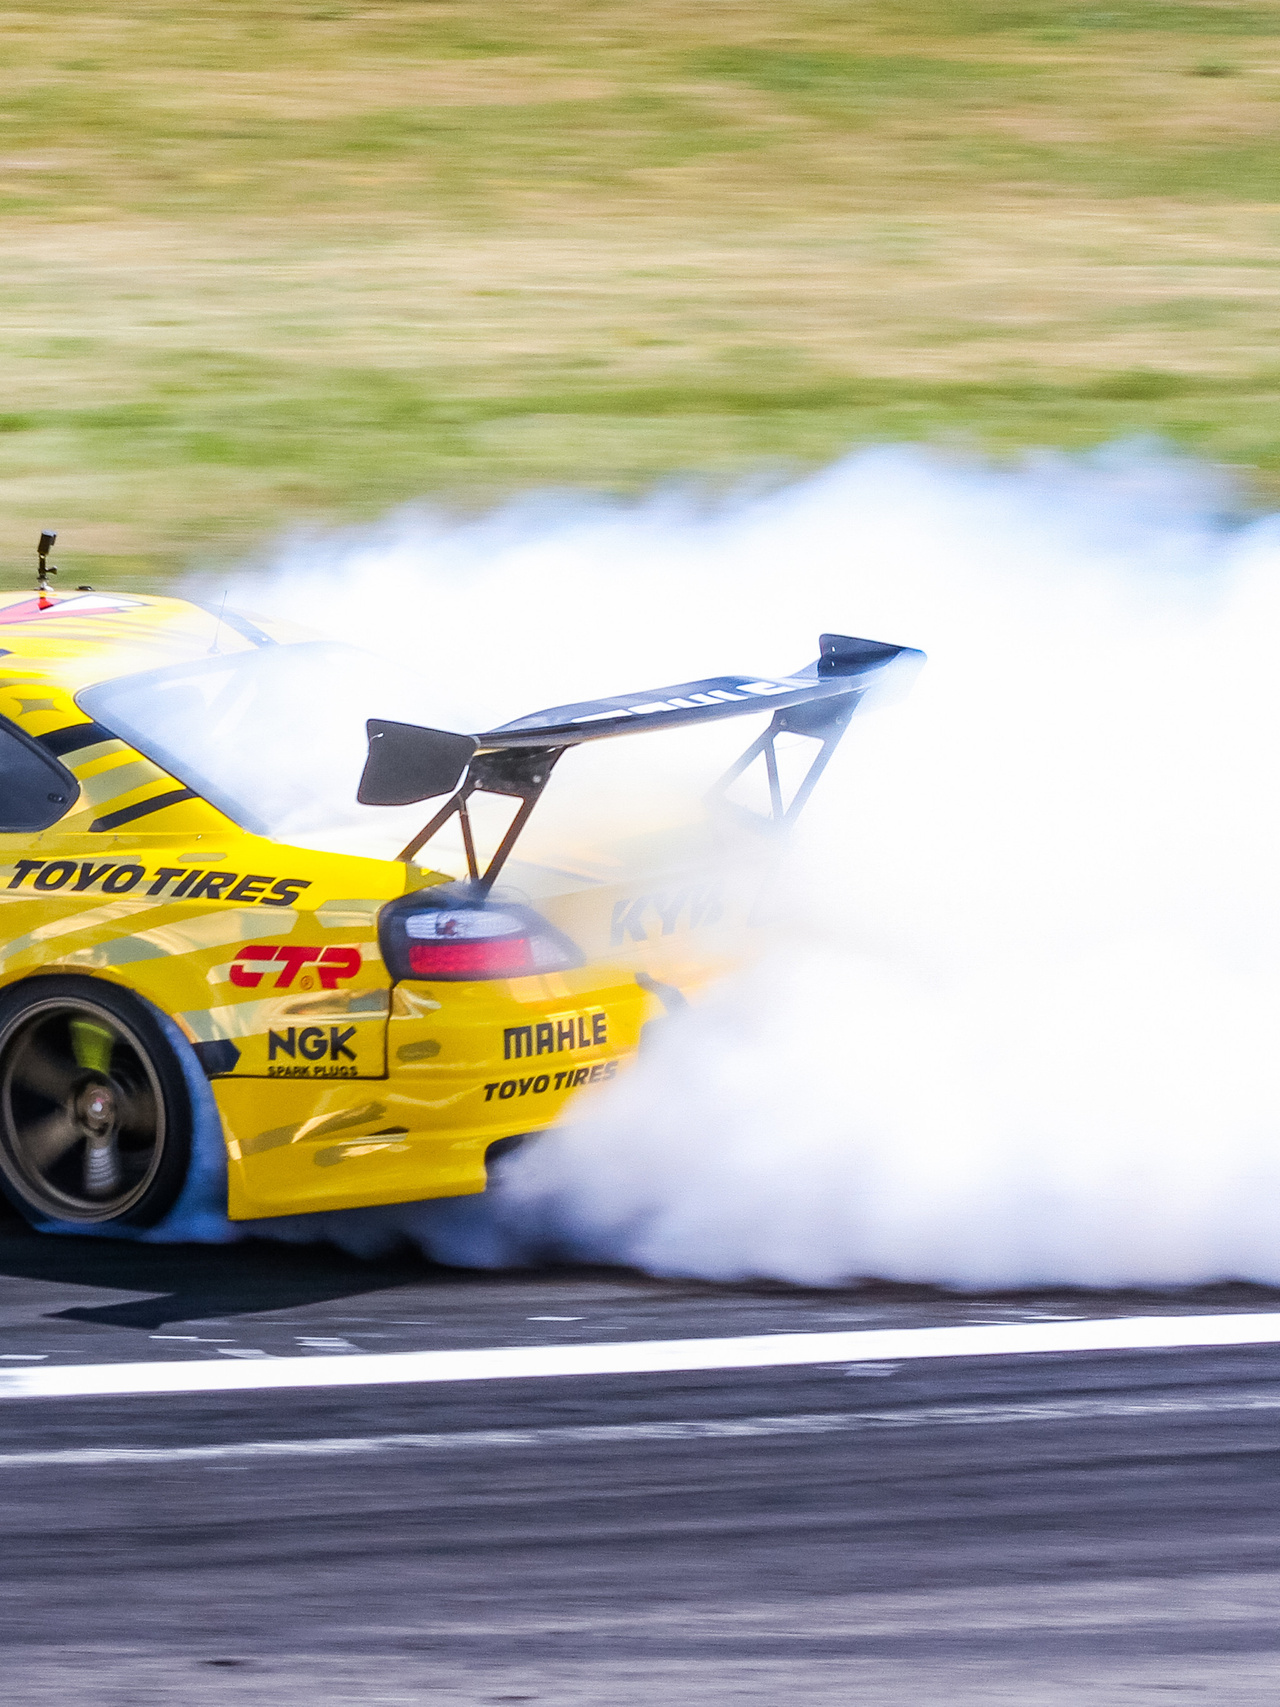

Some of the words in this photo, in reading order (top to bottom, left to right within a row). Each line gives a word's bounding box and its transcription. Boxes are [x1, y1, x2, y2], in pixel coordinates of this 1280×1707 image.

[7, 860, 146, 893] TOYO
[145, 868, 312, 906] TIRES
[268, 1026, 358, 1061] NGK
[504, 1013, 607, 1060] MAHLE
[268, 1065, 312, 1077] SPARK
[314, 1066, 358, 1077] PLUGS
[484, 1074, 550, 1102] TOYO
[554, 1060, 619, 1091] TIRES
